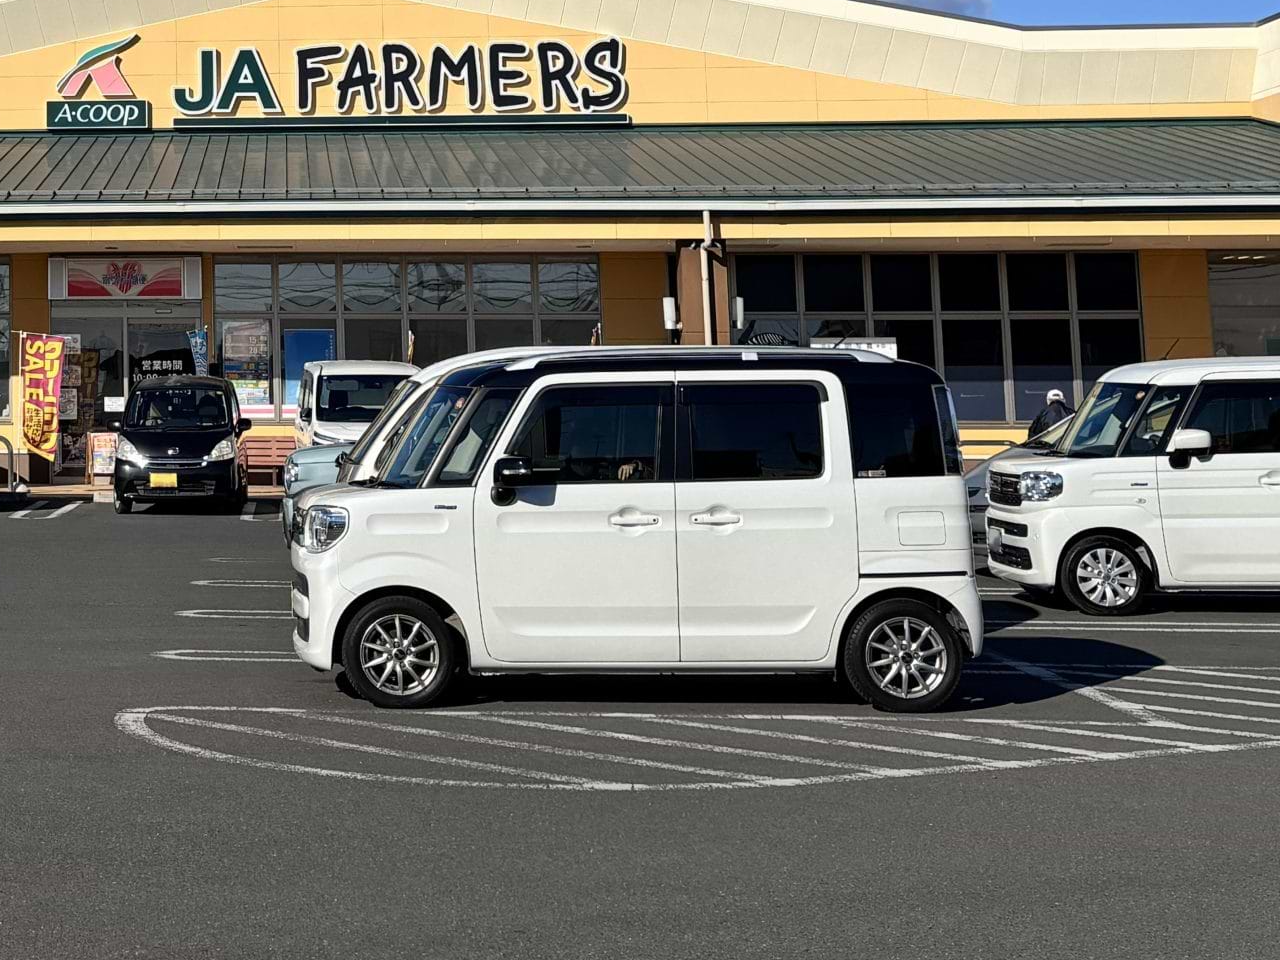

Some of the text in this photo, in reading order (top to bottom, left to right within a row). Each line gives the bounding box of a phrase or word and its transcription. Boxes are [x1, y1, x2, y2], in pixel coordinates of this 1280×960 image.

[172, 39, 624, 115] JA FARMERS
[24, 339, 46, 402] SALE
[141, 359, 183, 371] 営業時間
